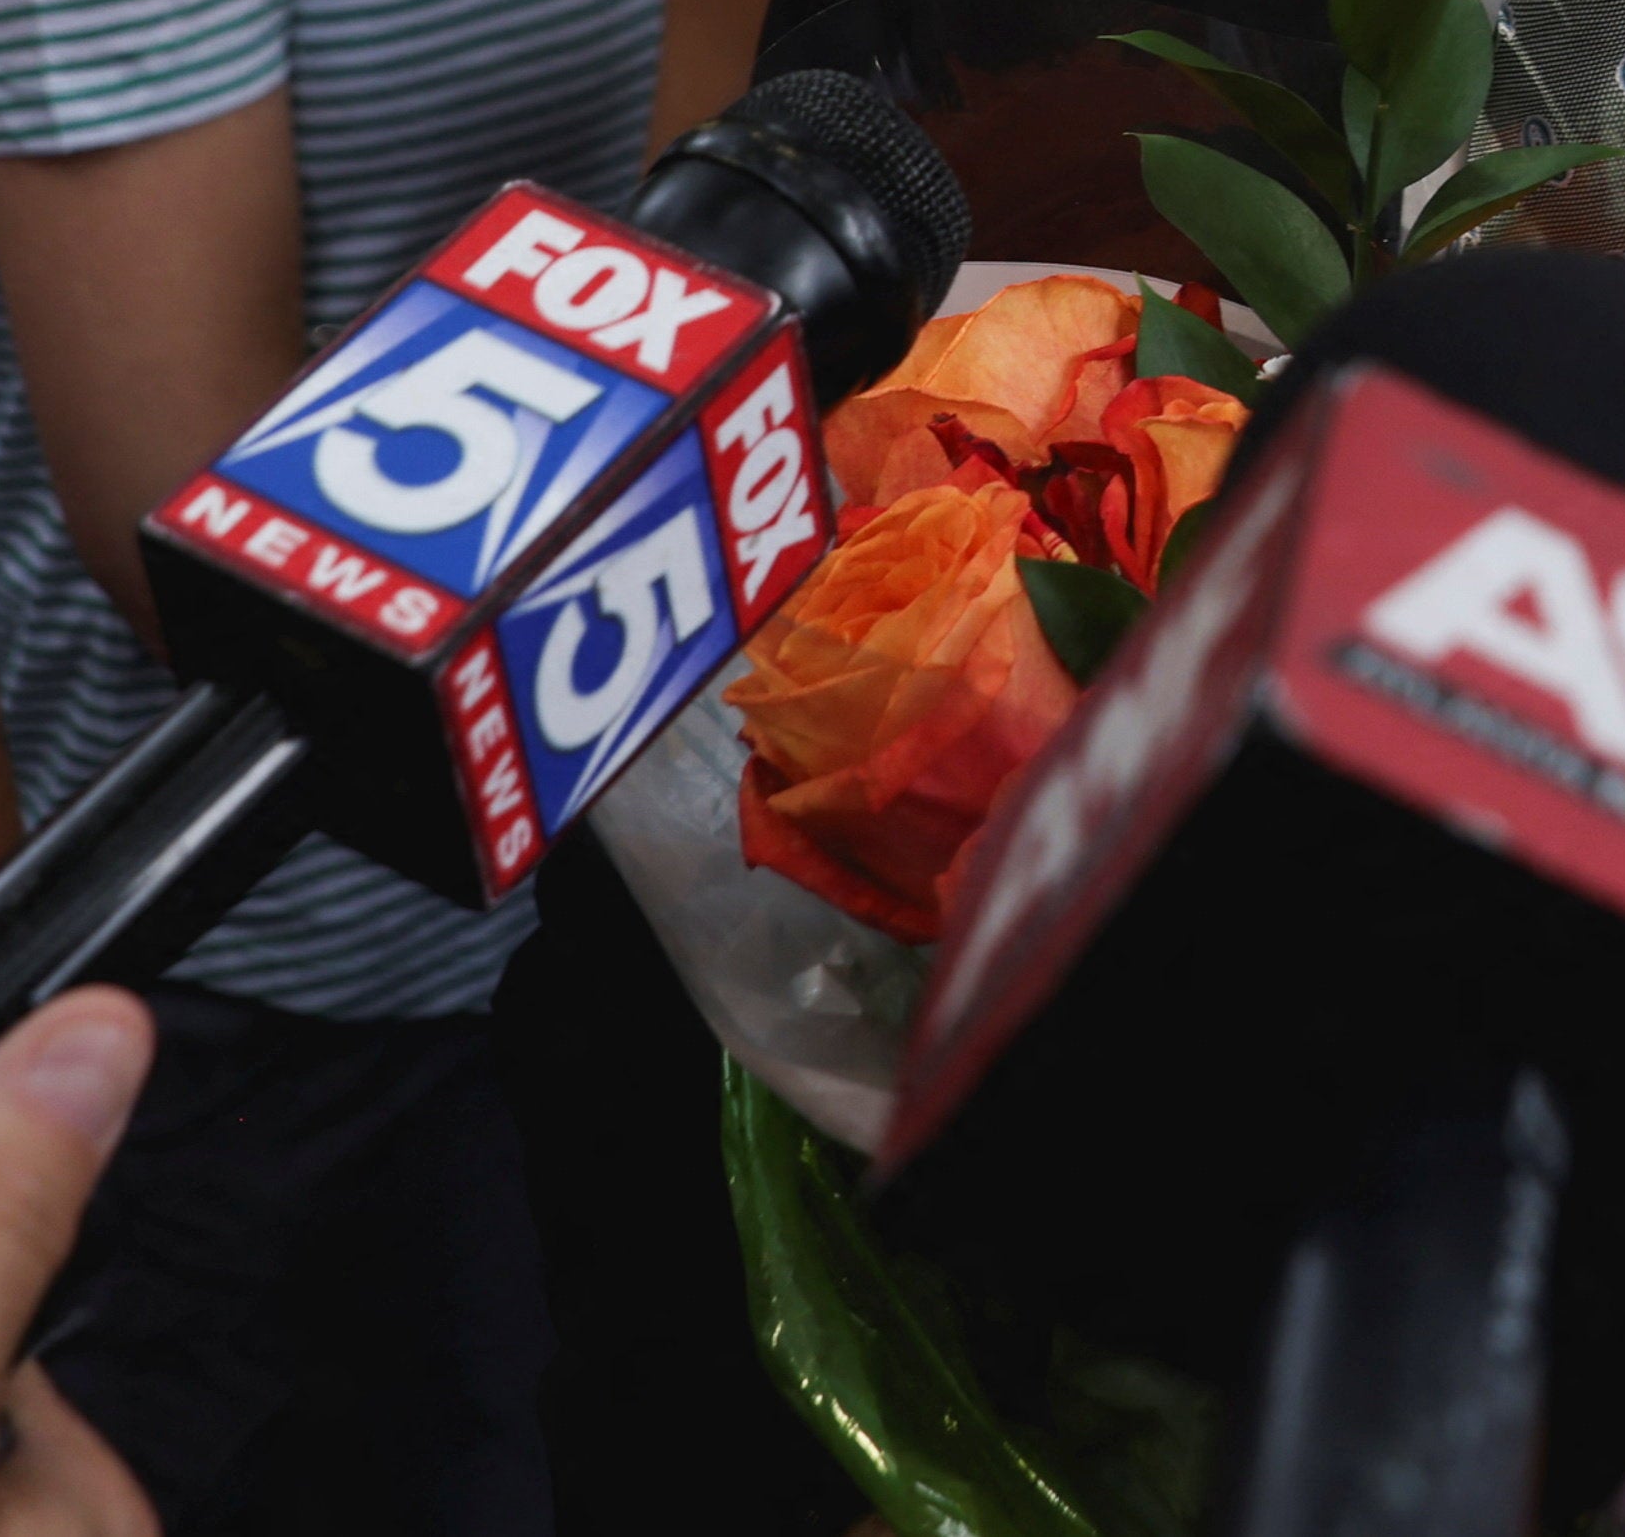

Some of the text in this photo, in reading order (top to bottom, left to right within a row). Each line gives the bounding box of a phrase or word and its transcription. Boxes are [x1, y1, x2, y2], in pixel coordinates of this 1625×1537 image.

[461, 208, 731, 375] FOX
[312, 327, 605, 537] 5
[715, 362, 816, 604] FOX
[178, 484, 441, 637] NEWS
[534, 505, 716, 755] 5
[452, 644, 533, 872] NEWS
